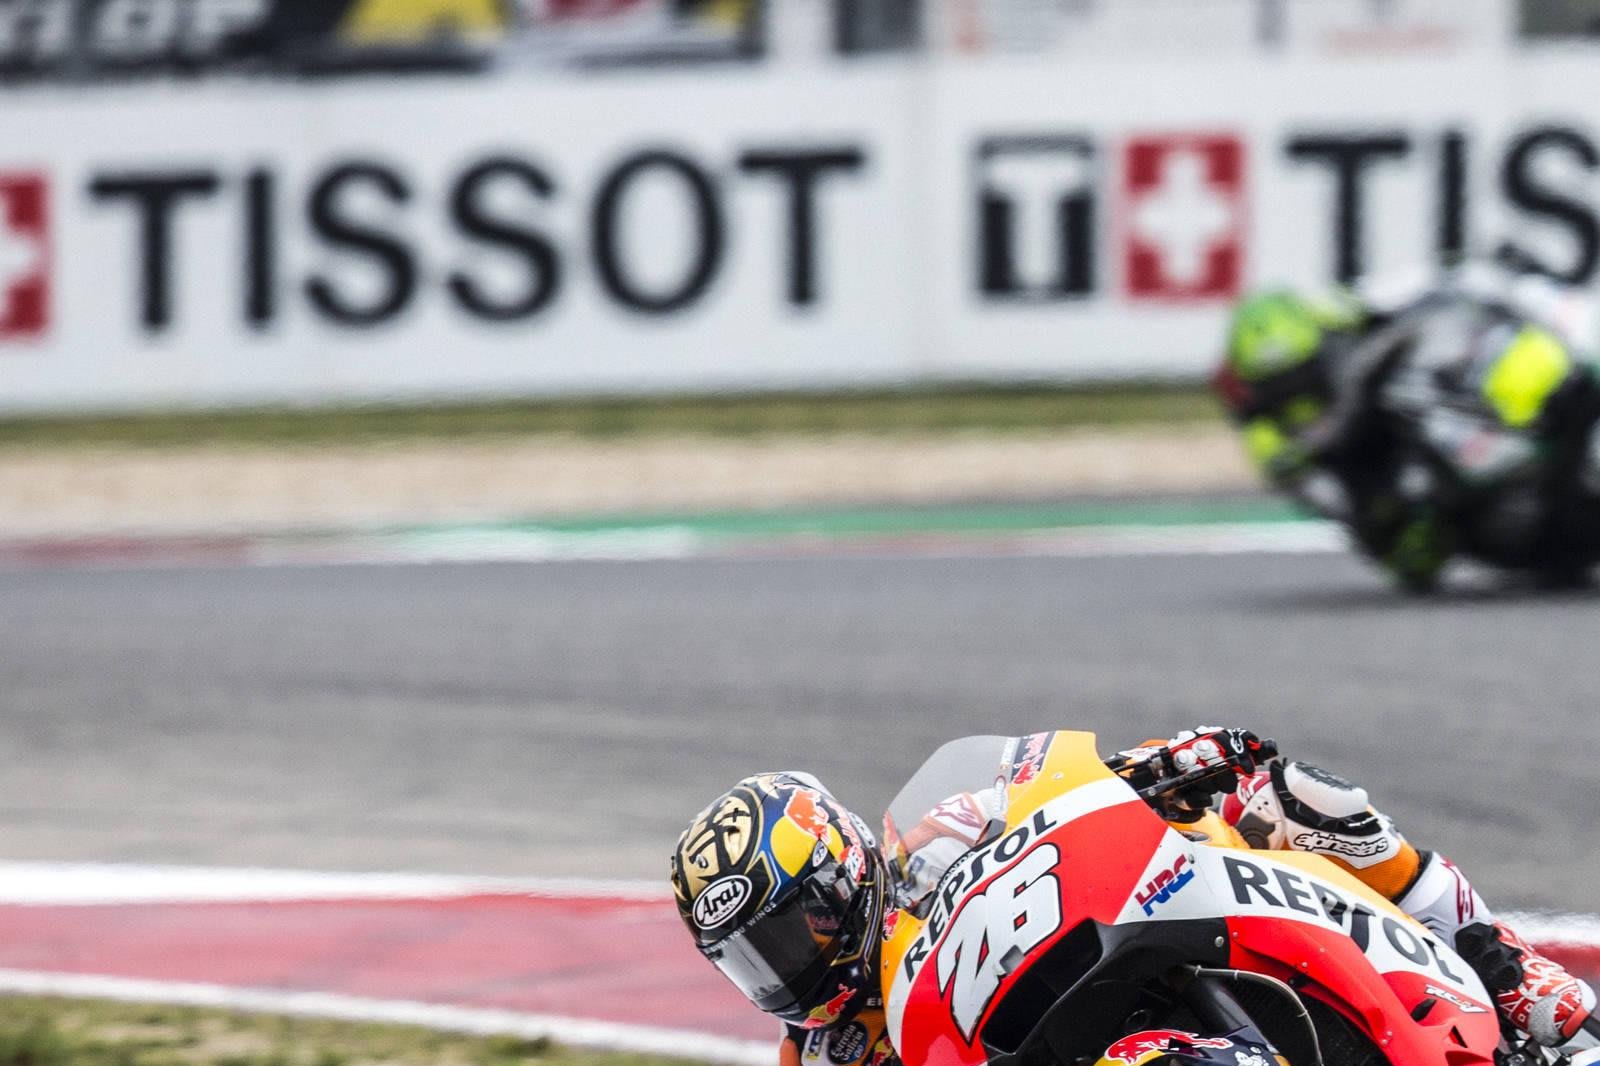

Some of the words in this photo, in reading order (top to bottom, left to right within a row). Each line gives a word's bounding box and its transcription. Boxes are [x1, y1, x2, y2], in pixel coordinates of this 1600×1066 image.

[87, 147, 866, 331] TISSOT
[700, 879, 740, 924] Arai
[905, 809, 1058, 981] REPSOL
[1294, 831, 1389, 858] alpinestars
[747, 901, 777, 927] WINGS
[937, 843, 1062, 1046] 26
[1222, 856, 1464, 985] REPSOL
